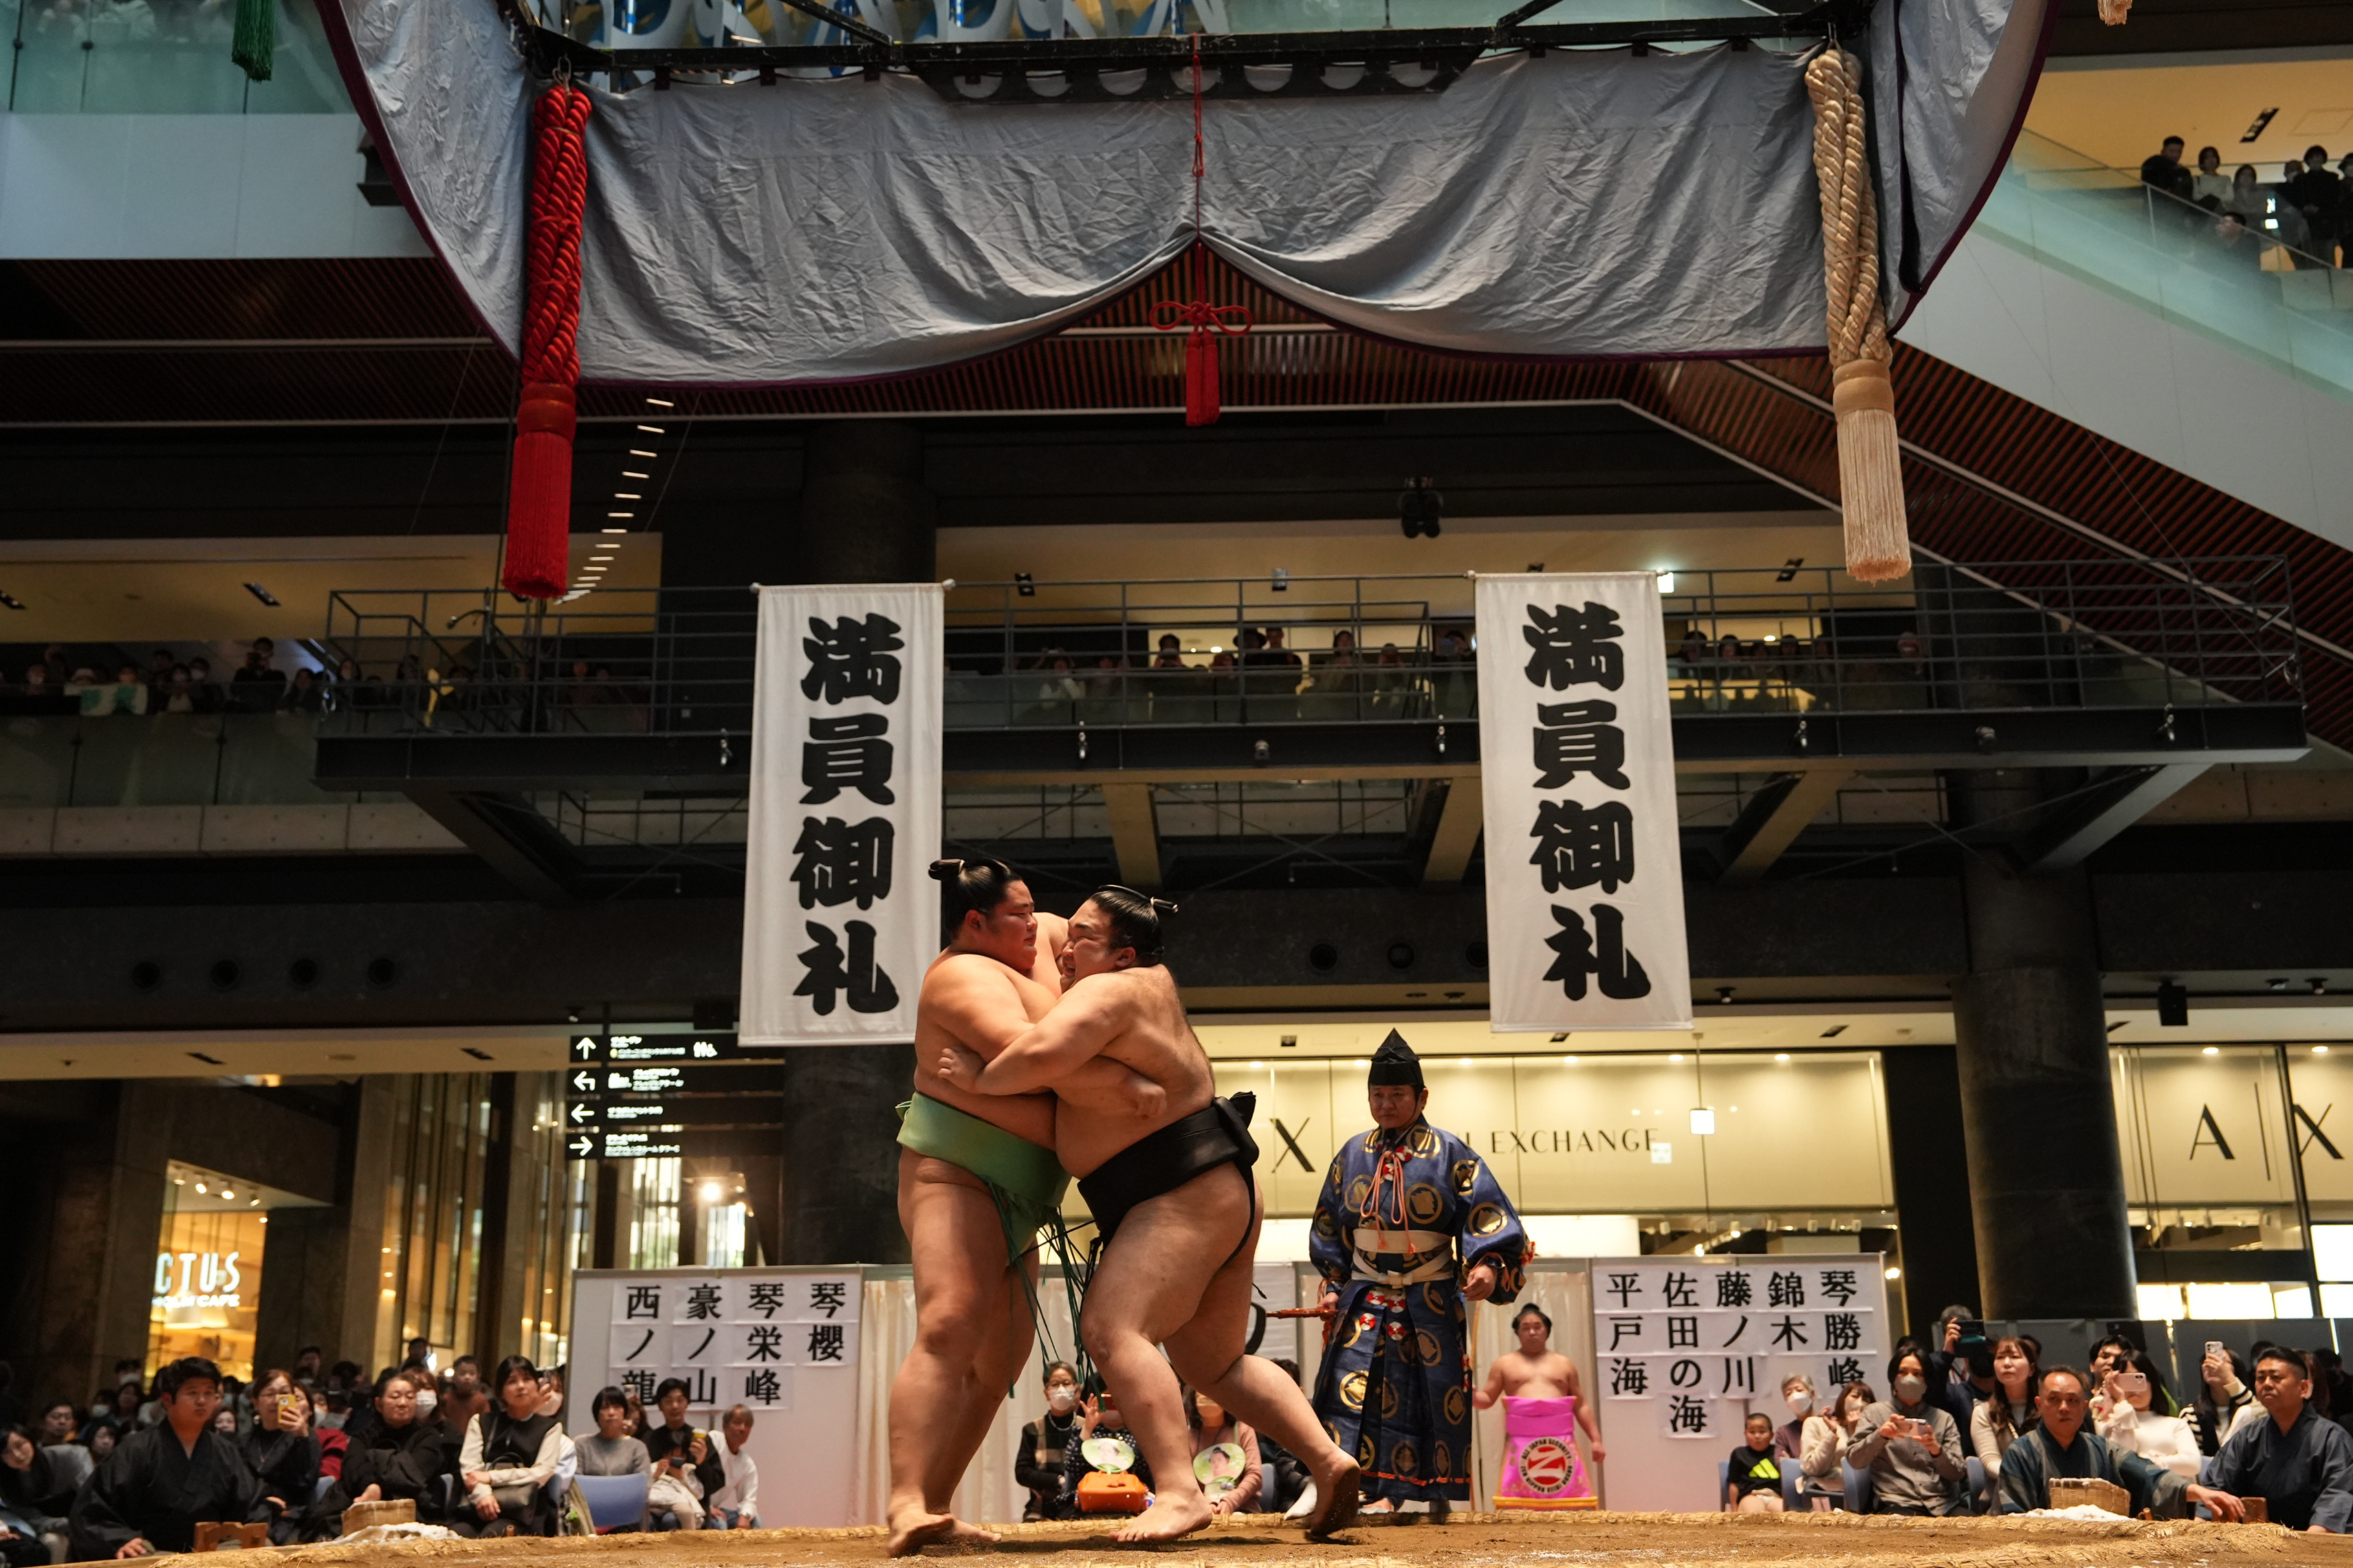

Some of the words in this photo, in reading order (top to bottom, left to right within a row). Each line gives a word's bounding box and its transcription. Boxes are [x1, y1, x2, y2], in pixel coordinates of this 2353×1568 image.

[789, 612, 905, 1016] 満員御礼
[1522, 601, 1651, 1001] 満員御礼
[1491, 1128, 1659, 1153] EXCHANGE
[197, 1294, 240, 1307] CAFE
[687, 1283, 723, 1404] 豪ノ山
[745, 1283, 785, 1405] 琴栄峰
[807, 1283, 846, 1362] 琴櫻
[1606, 1272, 1649, 1395] 平戸海
[1663, 1272, 1707, 1433] 佐田の海
[1716, 1270, 1754, 1394] 藤ノ川
[1767, 1271, 1808, 1351] 錦木
